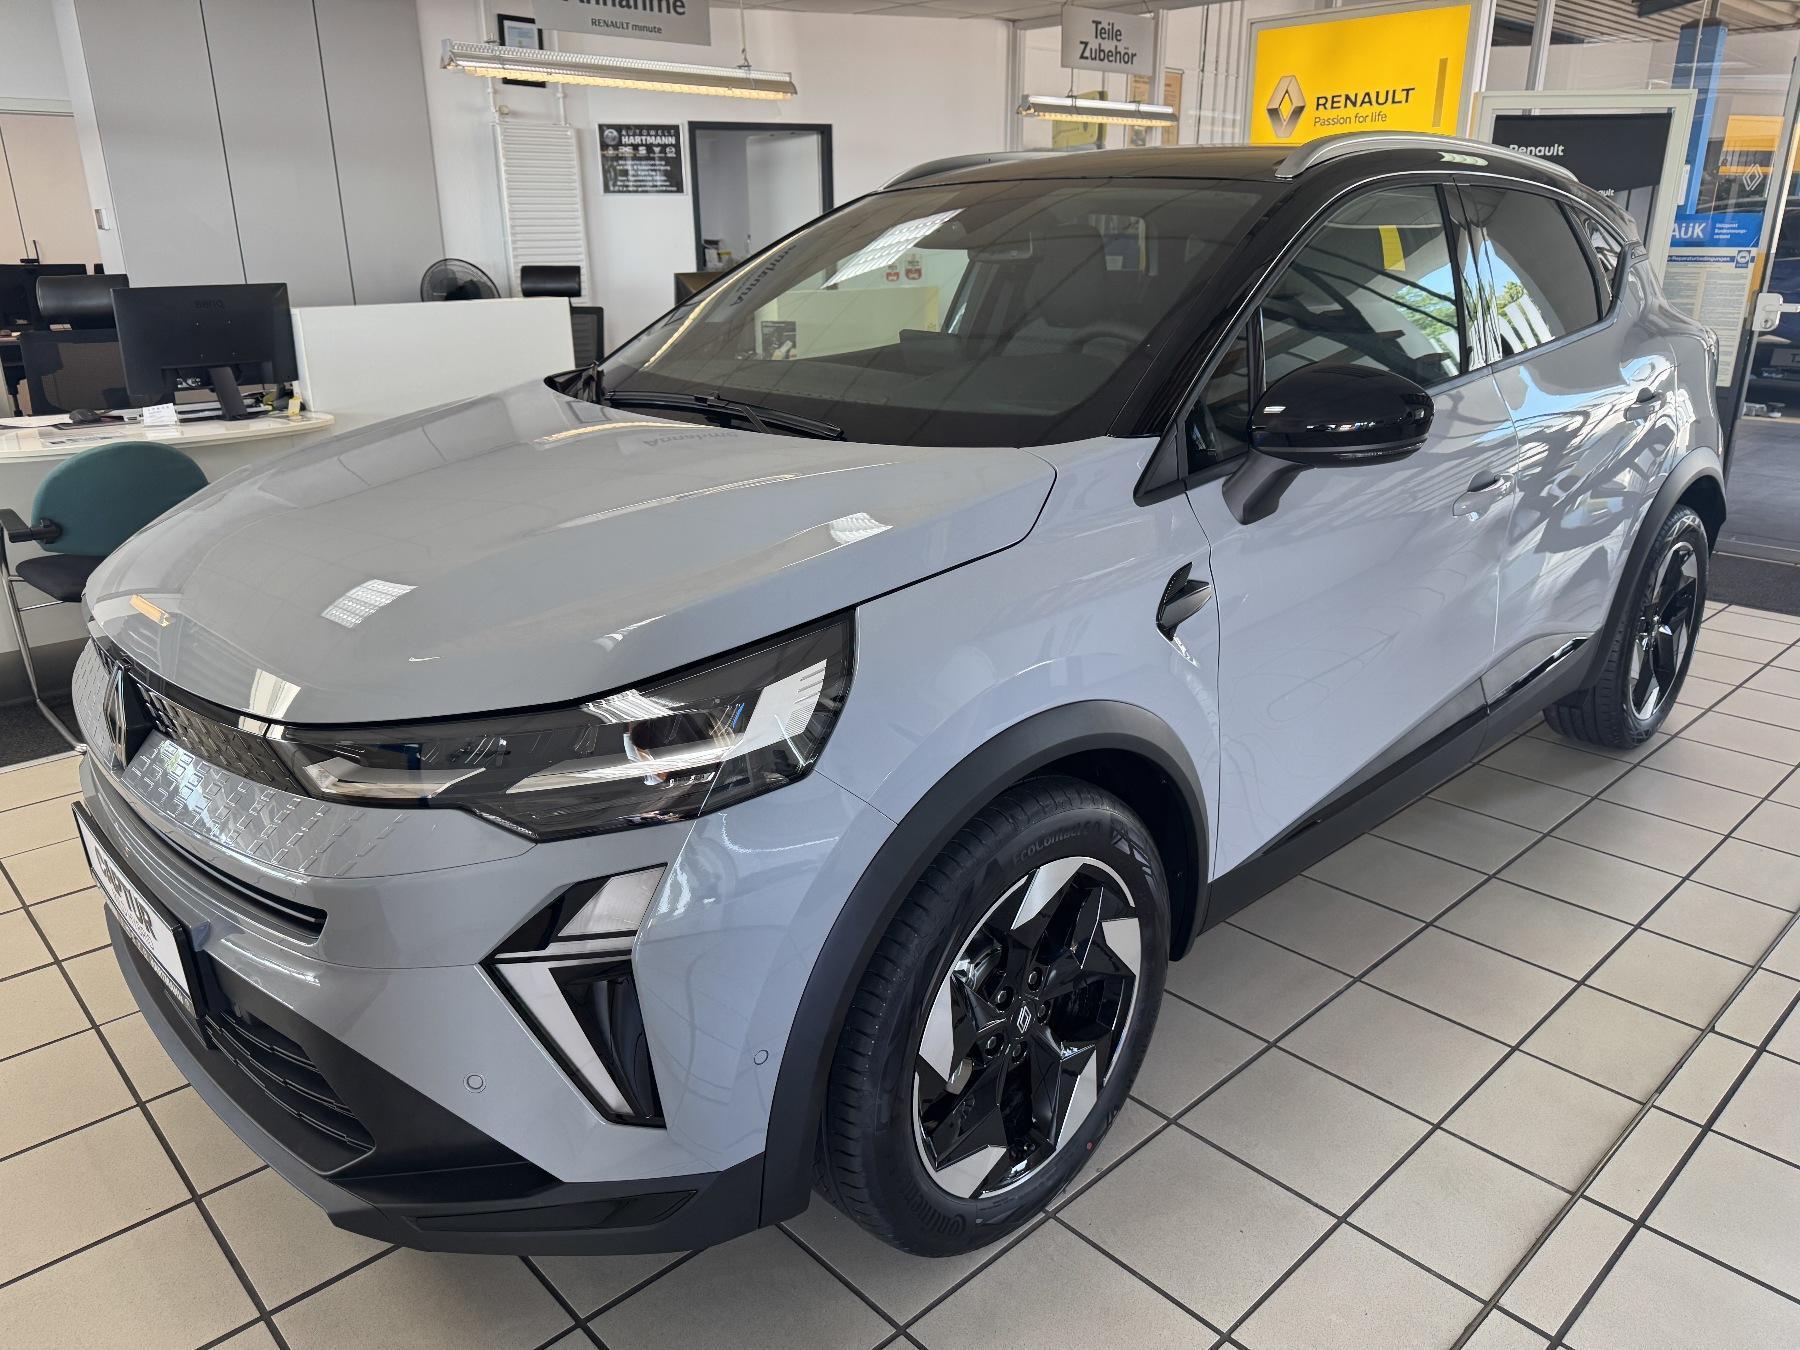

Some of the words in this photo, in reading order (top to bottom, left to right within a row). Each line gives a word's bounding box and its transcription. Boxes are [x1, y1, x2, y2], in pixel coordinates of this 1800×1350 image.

[591, 18, 630, 31] RENAULT
[631, 23, 663, 34] minute
[1091, 20, 1123, 42] Teile
[1079, 41, 1137, 65] Zubehör
[1315, 87, 1415, 111] RENAULT
[1313, 115, 1351, 127] Passion
[1354, 112, 1369, 124] for
[1370, 111, 1388, 123] life
[621, 136, 676, 144] HARTMANN
